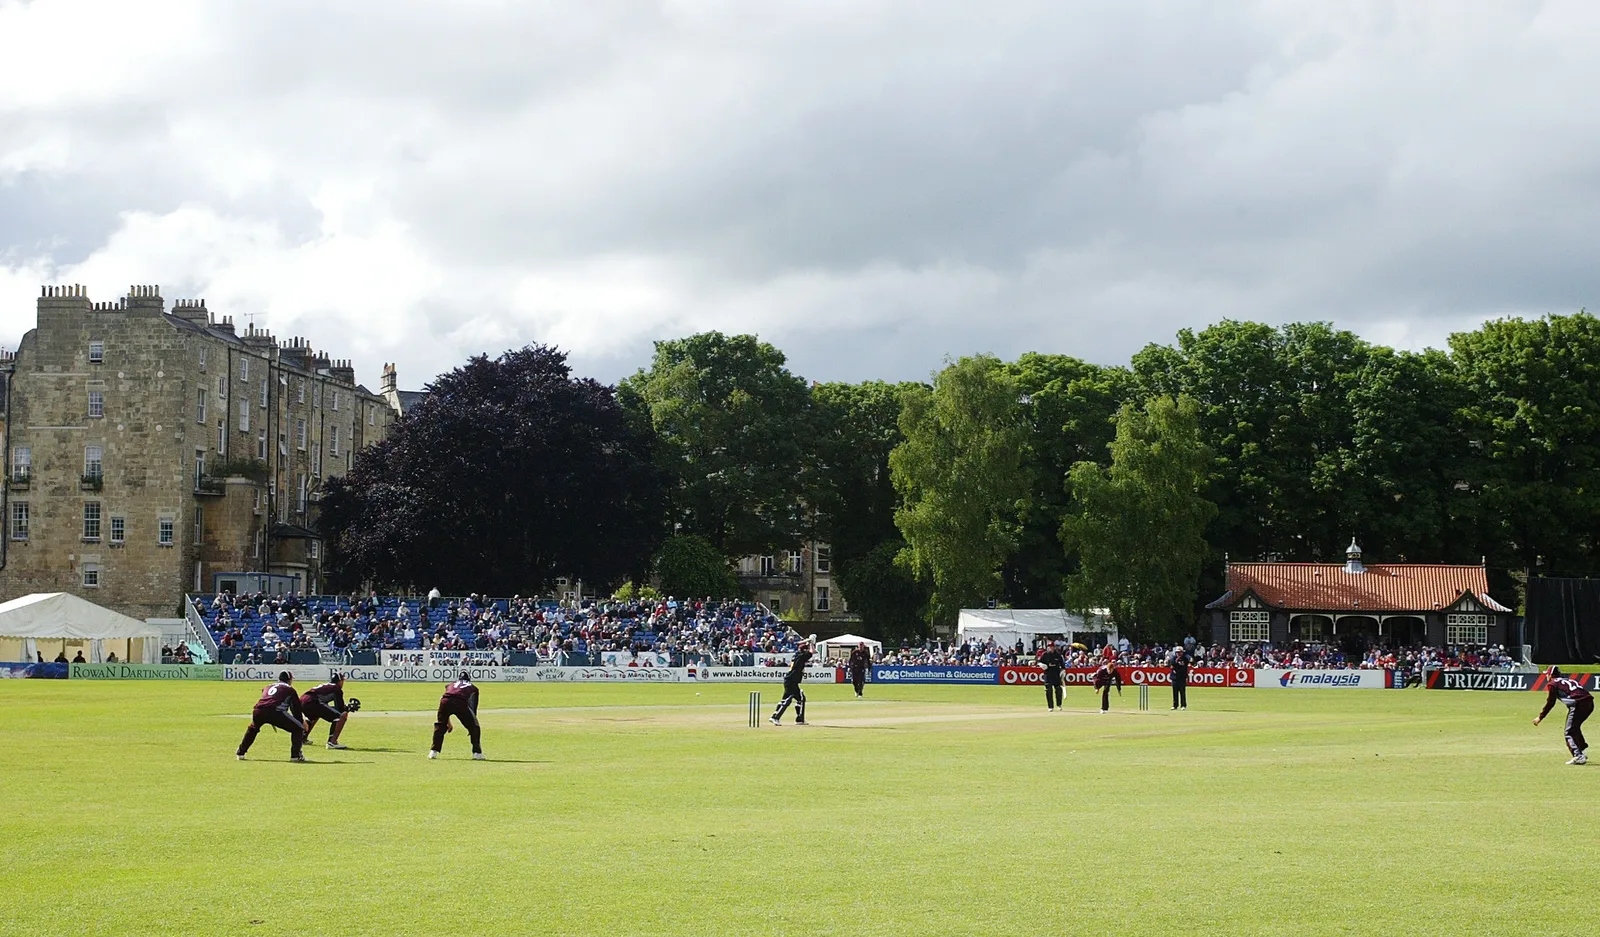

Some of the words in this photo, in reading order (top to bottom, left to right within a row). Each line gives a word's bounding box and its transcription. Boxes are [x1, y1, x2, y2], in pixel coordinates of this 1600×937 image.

[225, 667, 274, 679] BioCare
[383, 666, 428, 681] optika
[432, 666, 497, 682] optiians
[877, 670, 900, 680] C&G
[900, 670, 946, 678] Cheltenham
[946, 670, 953, 678] &
[954, 670, 995, 679] Gloucester
[1300, 673, 1361, 686] malaysia
[1443, 673, 1527, 689] FRIZZELL
[267, 685, 278, 696] 6
